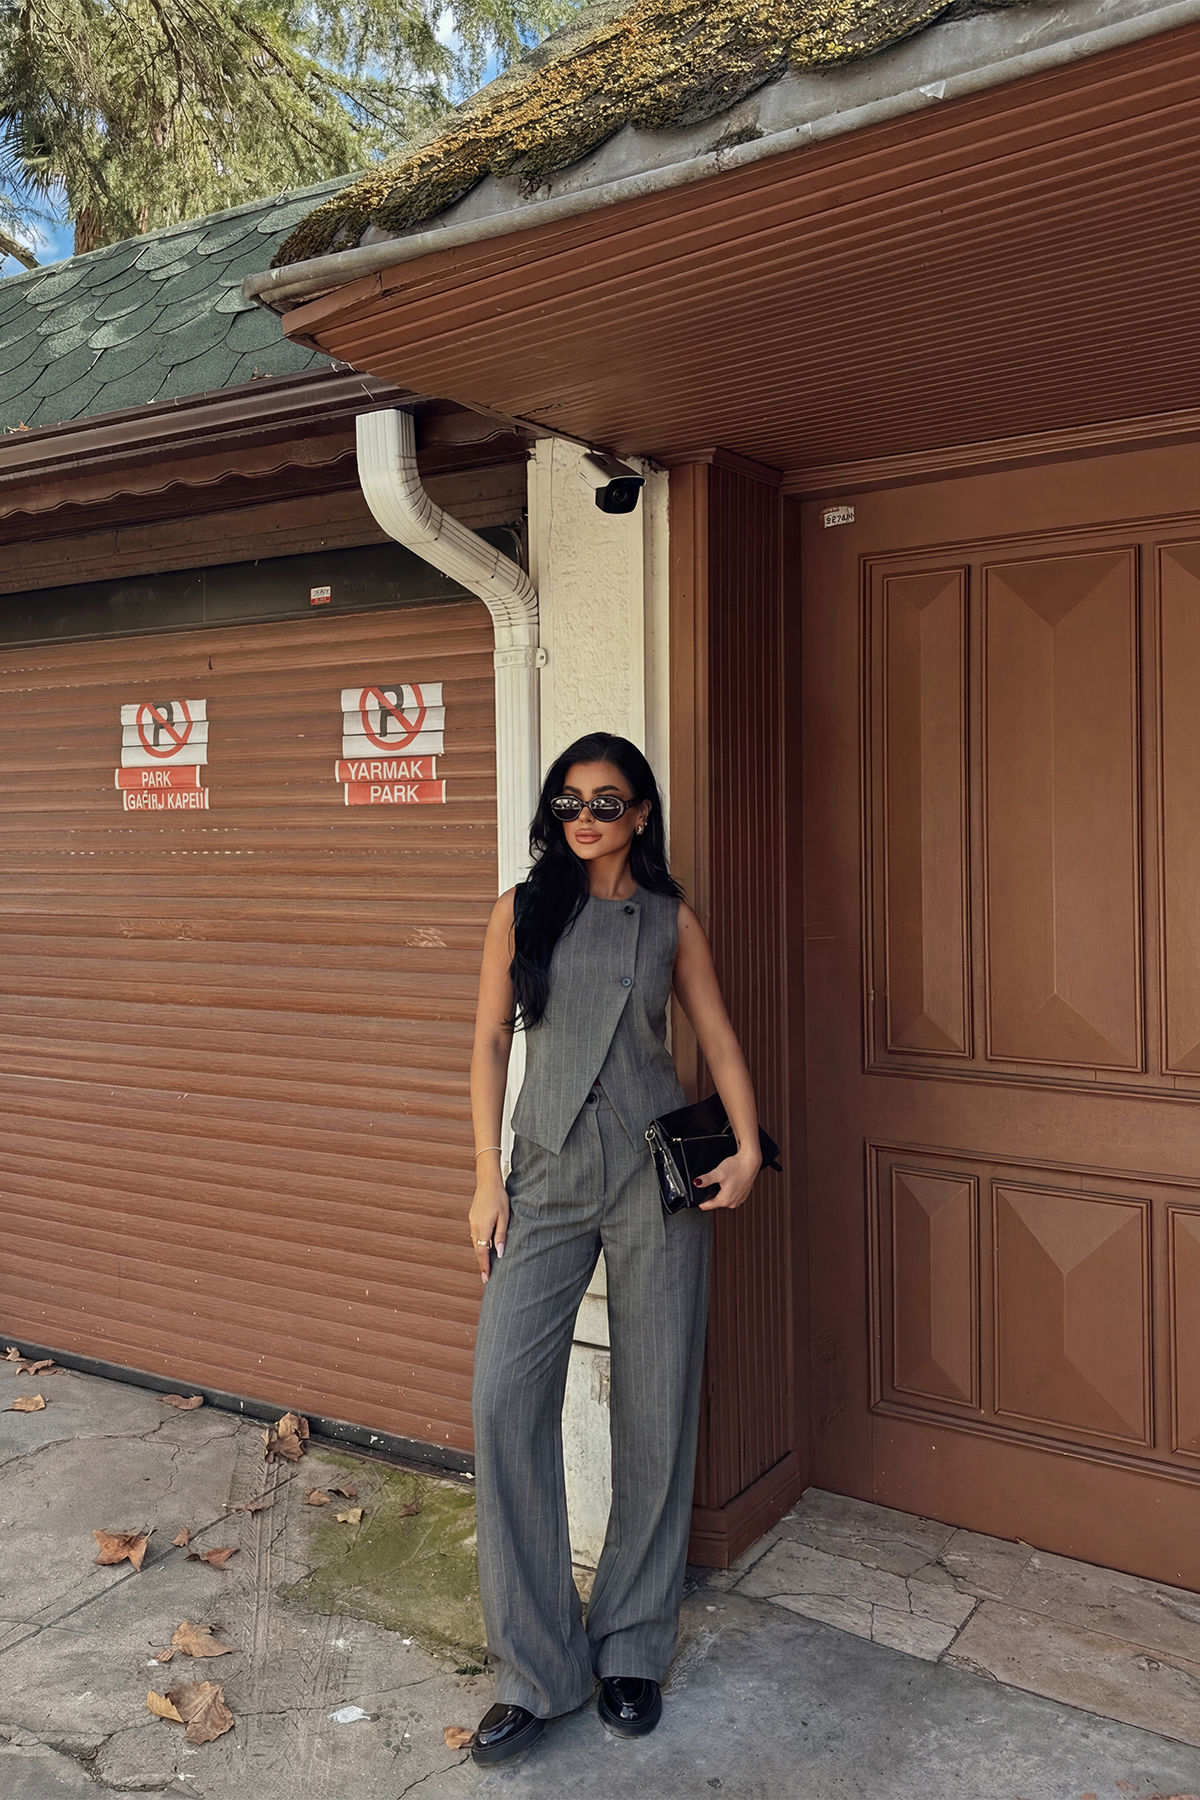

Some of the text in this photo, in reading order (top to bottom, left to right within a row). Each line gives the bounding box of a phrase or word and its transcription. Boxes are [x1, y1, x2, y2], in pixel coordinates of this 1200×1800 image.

[142, 771, 172, 787] PARK
[347, 760, 423, 780] YARMAK
[370, 784, 420, 803] PARK
